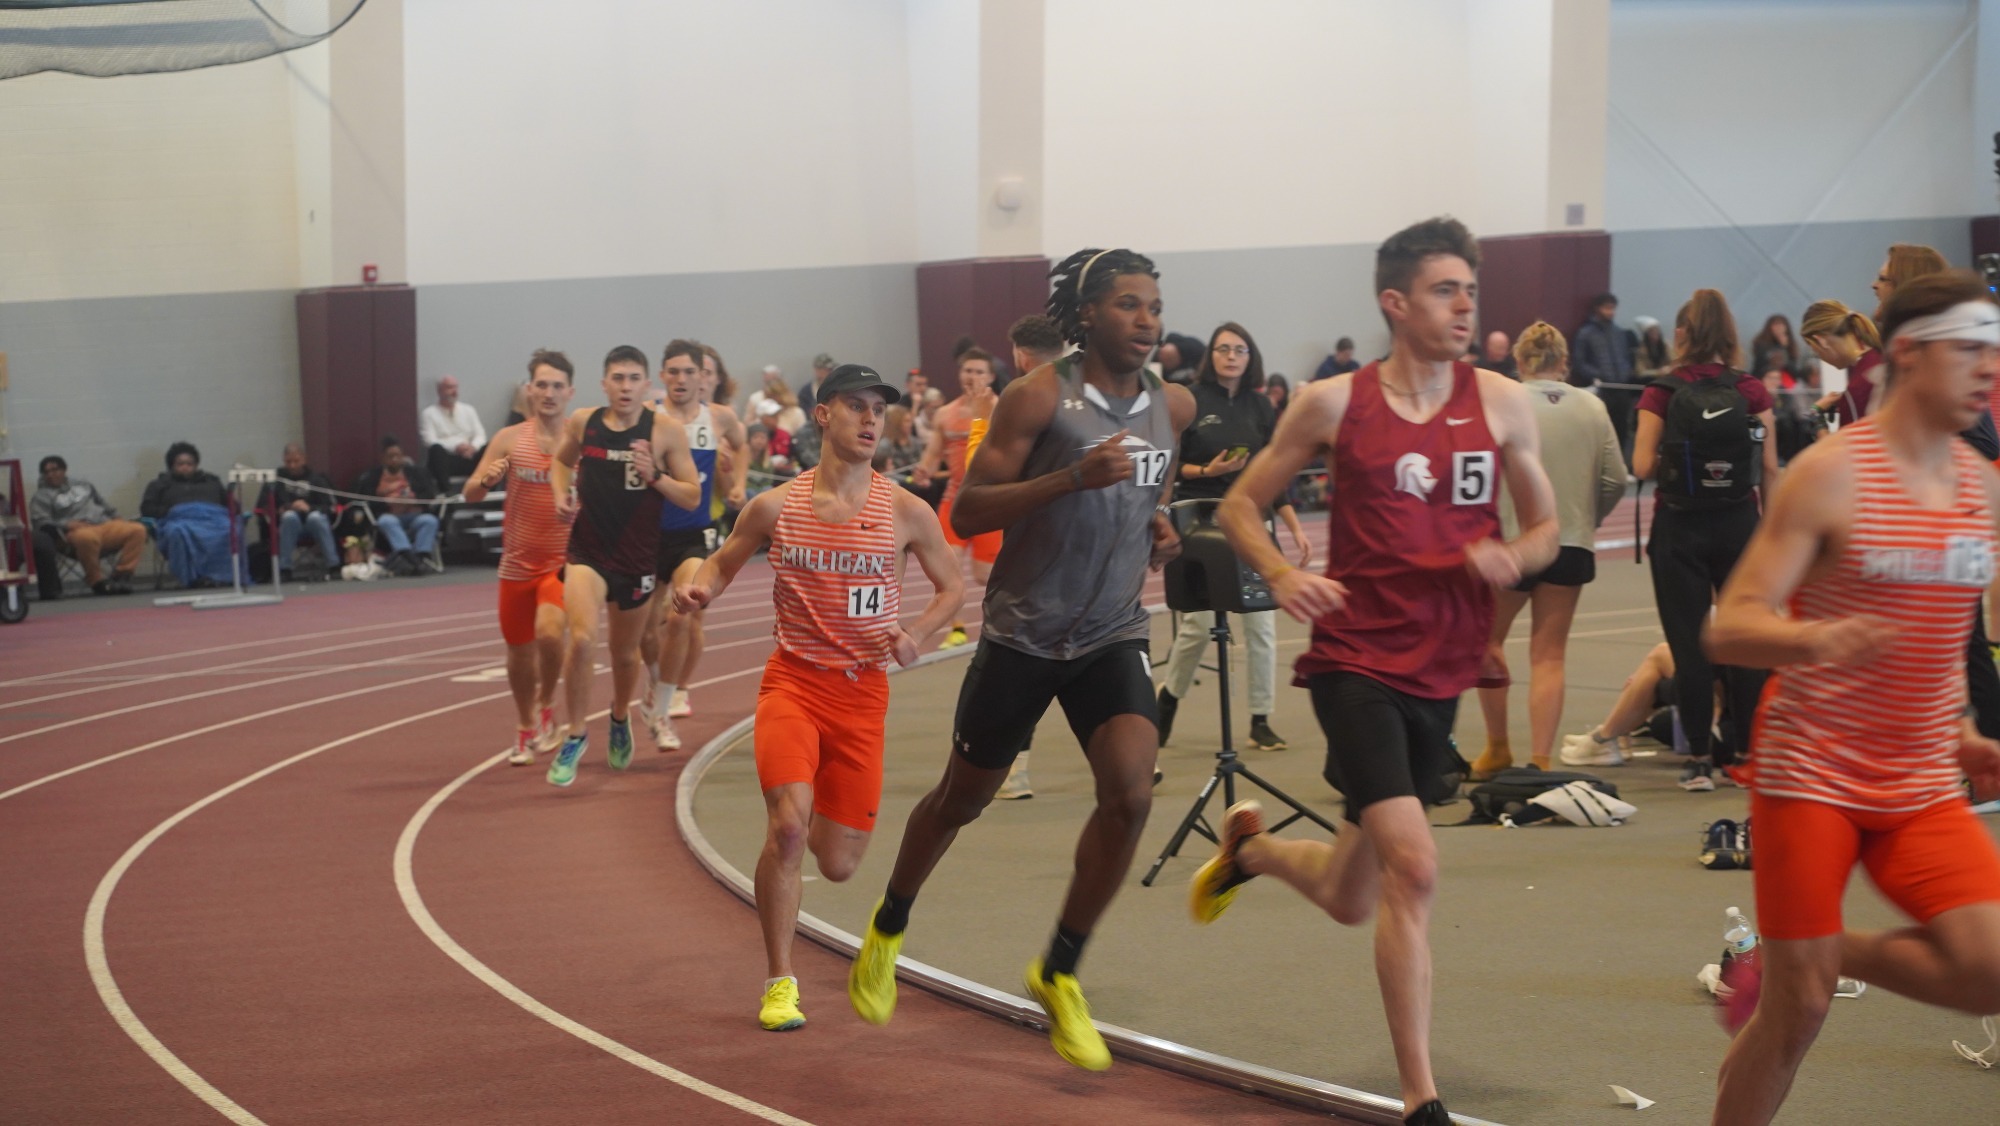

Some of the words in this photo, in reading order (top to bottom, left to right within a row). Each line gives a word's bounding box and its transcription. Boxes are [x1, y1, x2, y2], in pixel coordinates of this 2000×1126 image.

[1142, 451, 1167, 484] 12
[1460, 456, 1485, 500] 5
[781, 545, 885, 576] MILLIGAN
[852, 587, 880, 616] 14
